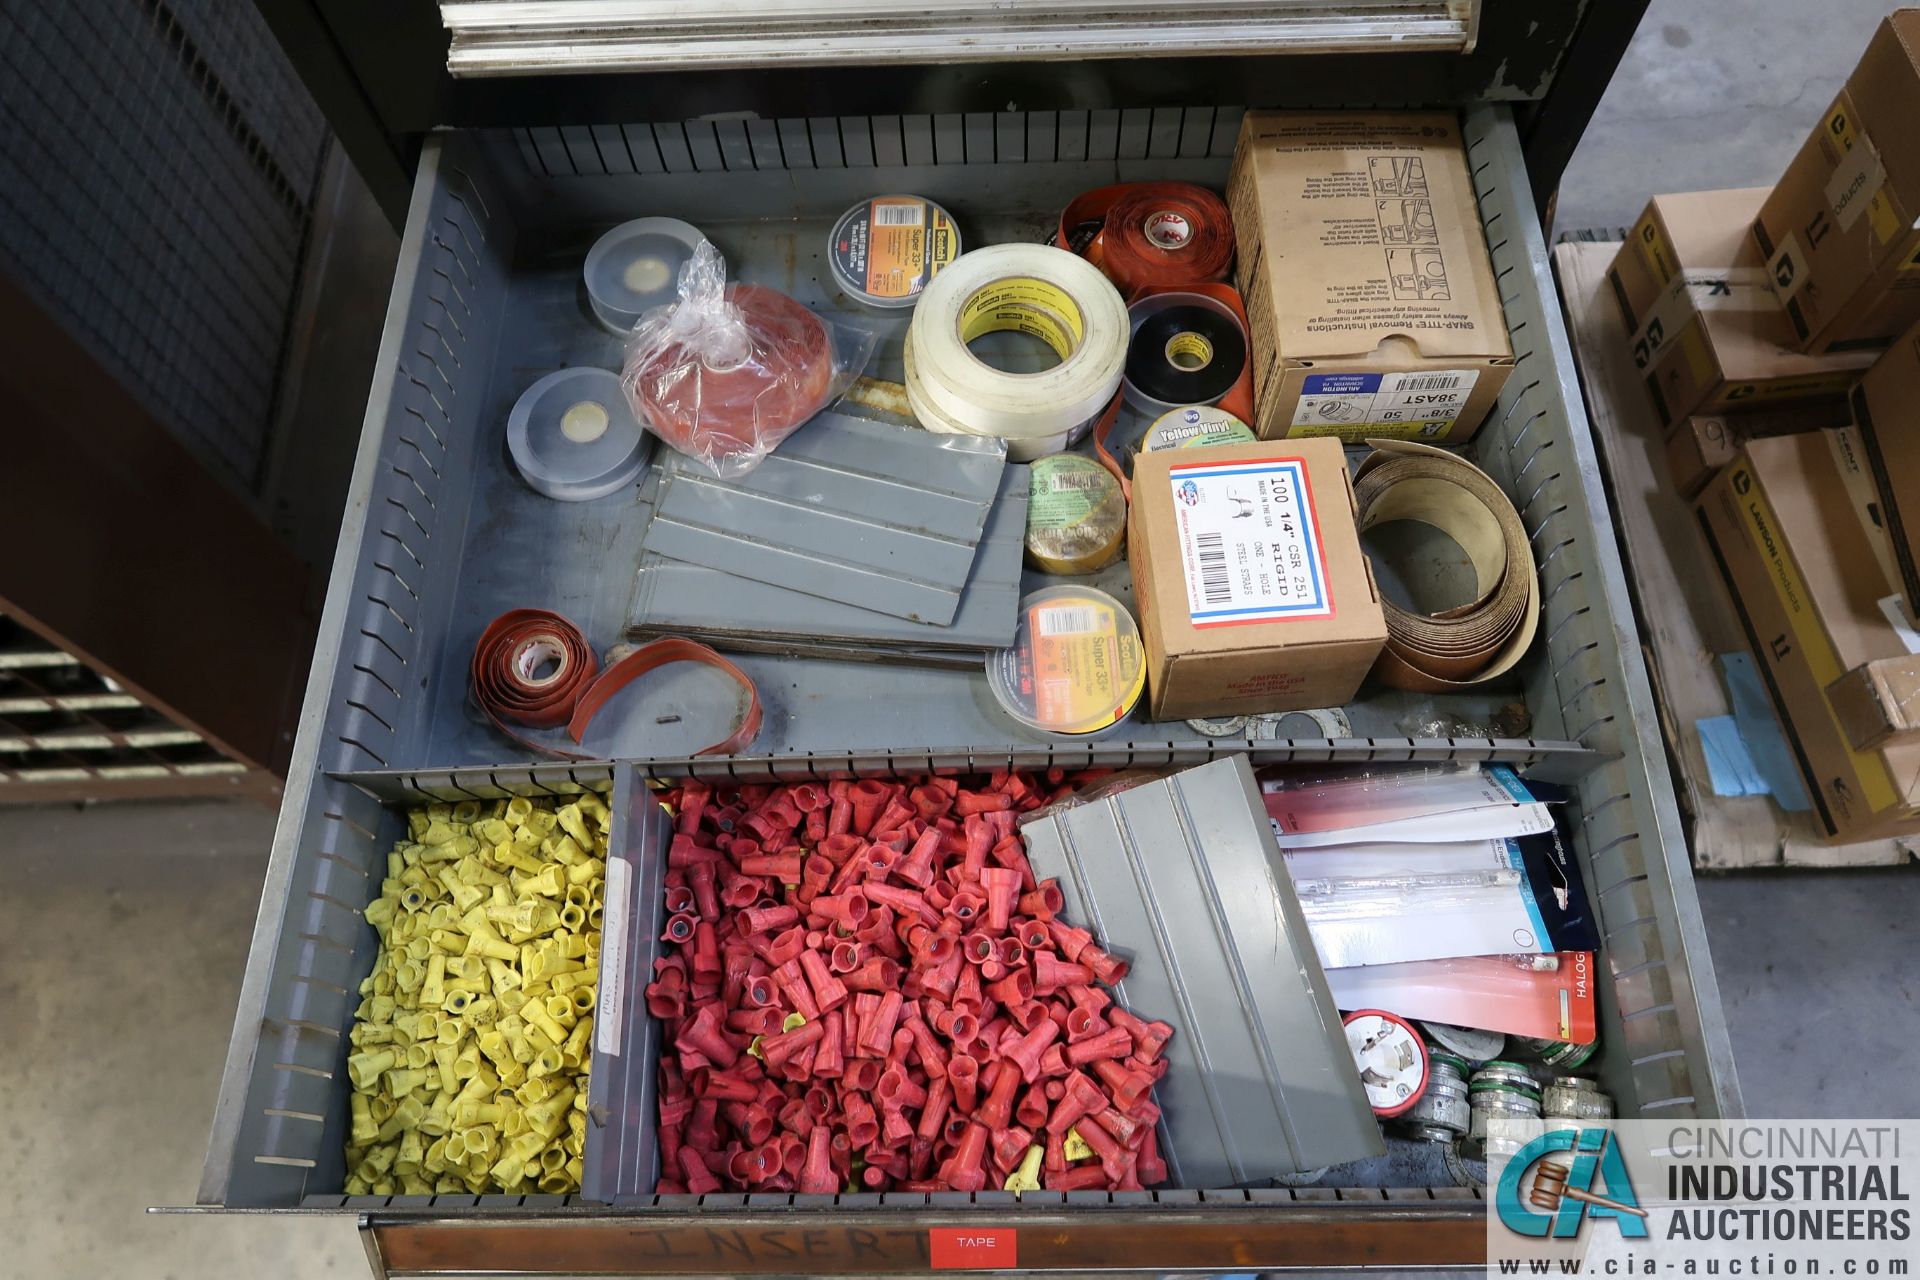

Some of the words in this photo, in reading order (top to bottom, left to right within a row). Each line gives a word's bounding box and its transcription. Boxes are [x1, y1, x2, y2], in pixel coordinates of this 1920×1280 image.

[1370, 157, 1378, 168] 3
[1379, 200, 1387, 211] 2
[913, 229, 921, 250] Super
[937, 230, 946, 260] Scotch
[1389, 248, 1395, 260] 1
[1306, 323, 1366, 332] Instructions
[1370, 321, 1413, 330] Removal
[1403, 393, 1458, 404] 38AST
[1384, 411, 1403, 420] 50
[1422, 408, 1455, 418] 3/8"
[1159, 426, 1200, 442] Yellow
[1200, 420, 1230, 434] Vinyl
[1151, 442, 1176, 452] Electrical
[1271, 478, 1289, 503] 100
[1181, 509, 1190, 534] AMERICAN
[1264, 515, 1272, 528] USA
[1280, 512, 1295, 538] 1/4"
[1184, 534, 1193, 557] FITTINGS
[1236, 543, 1247, 565] STEEL
[1254, 541, 1264, 557] ONE
[1259, 573, 1271, 595] HOLE
[1288, 545, 1301, 569] CSR
[1749, 502, 1778, 558] LAWSON
[1775, 558, 1801, 613] Products
[1272, 543, 1288, 596] RIGID
[1241, 568, 1253, 595] STRAPS
[1294, 576, 1307, 599] 251
[1093, 636, 1104, 669] Super
[1096, 672, 1108, 693] 33+
[1576, 951, 1586, 998] HALOG
[957, 1237, 996, 1248] TAPE
